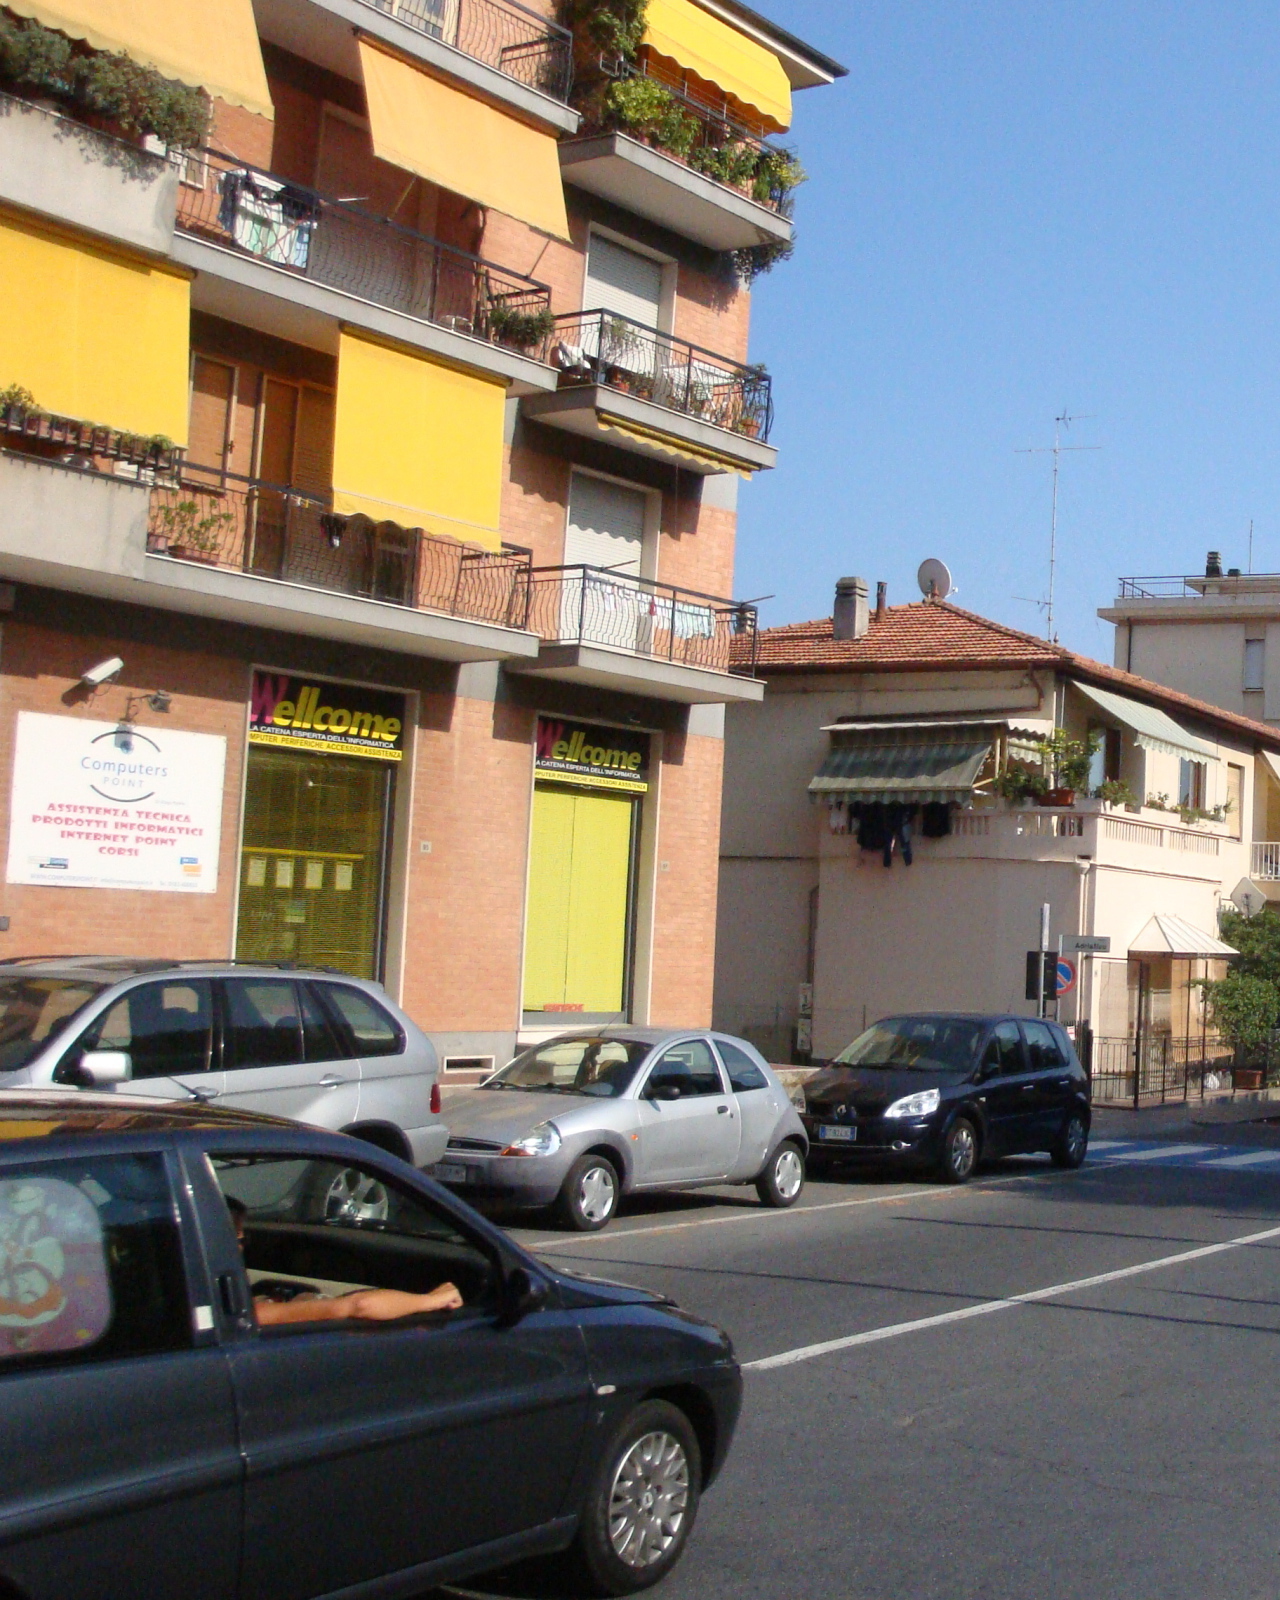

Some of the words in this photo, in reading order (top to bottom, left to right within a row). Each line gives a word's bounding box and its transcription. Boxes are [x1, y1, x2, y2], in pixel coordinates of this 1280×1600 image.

[250, 672, 401, 741] Wellcome
[260, 726, 291, 736] CATENA
[292, 730, 326, 740] ESPERTA
[326, 735, 395, 749] DELL'INFORMATICA
[537, 720, 641, 771] Wellcome
[281, 738, 325, 749] PERIFERICHE
[327, 743, 364, 754] ACCESSORI
[364, 747, 402, 759] ASSISTENZA
[81, 756, 168, 778] Computers
[541, 760, 566, 769] CATENA
[566, 763, 590, 772] ESPERTA
[103, 777, 144, 788] POINT
[47, 803, 130, 818] ASSISTENZA
[136, 810, 191, 823] TECNICA
[31, 814, 108, 829] PRODOTTI
[114, 821, 204, 836] INFORMATICI
[60, 830, 129, 843] INTERNET
[135, 836, 177, 847] POINT
[98, 846, 140, 857] CORSI
